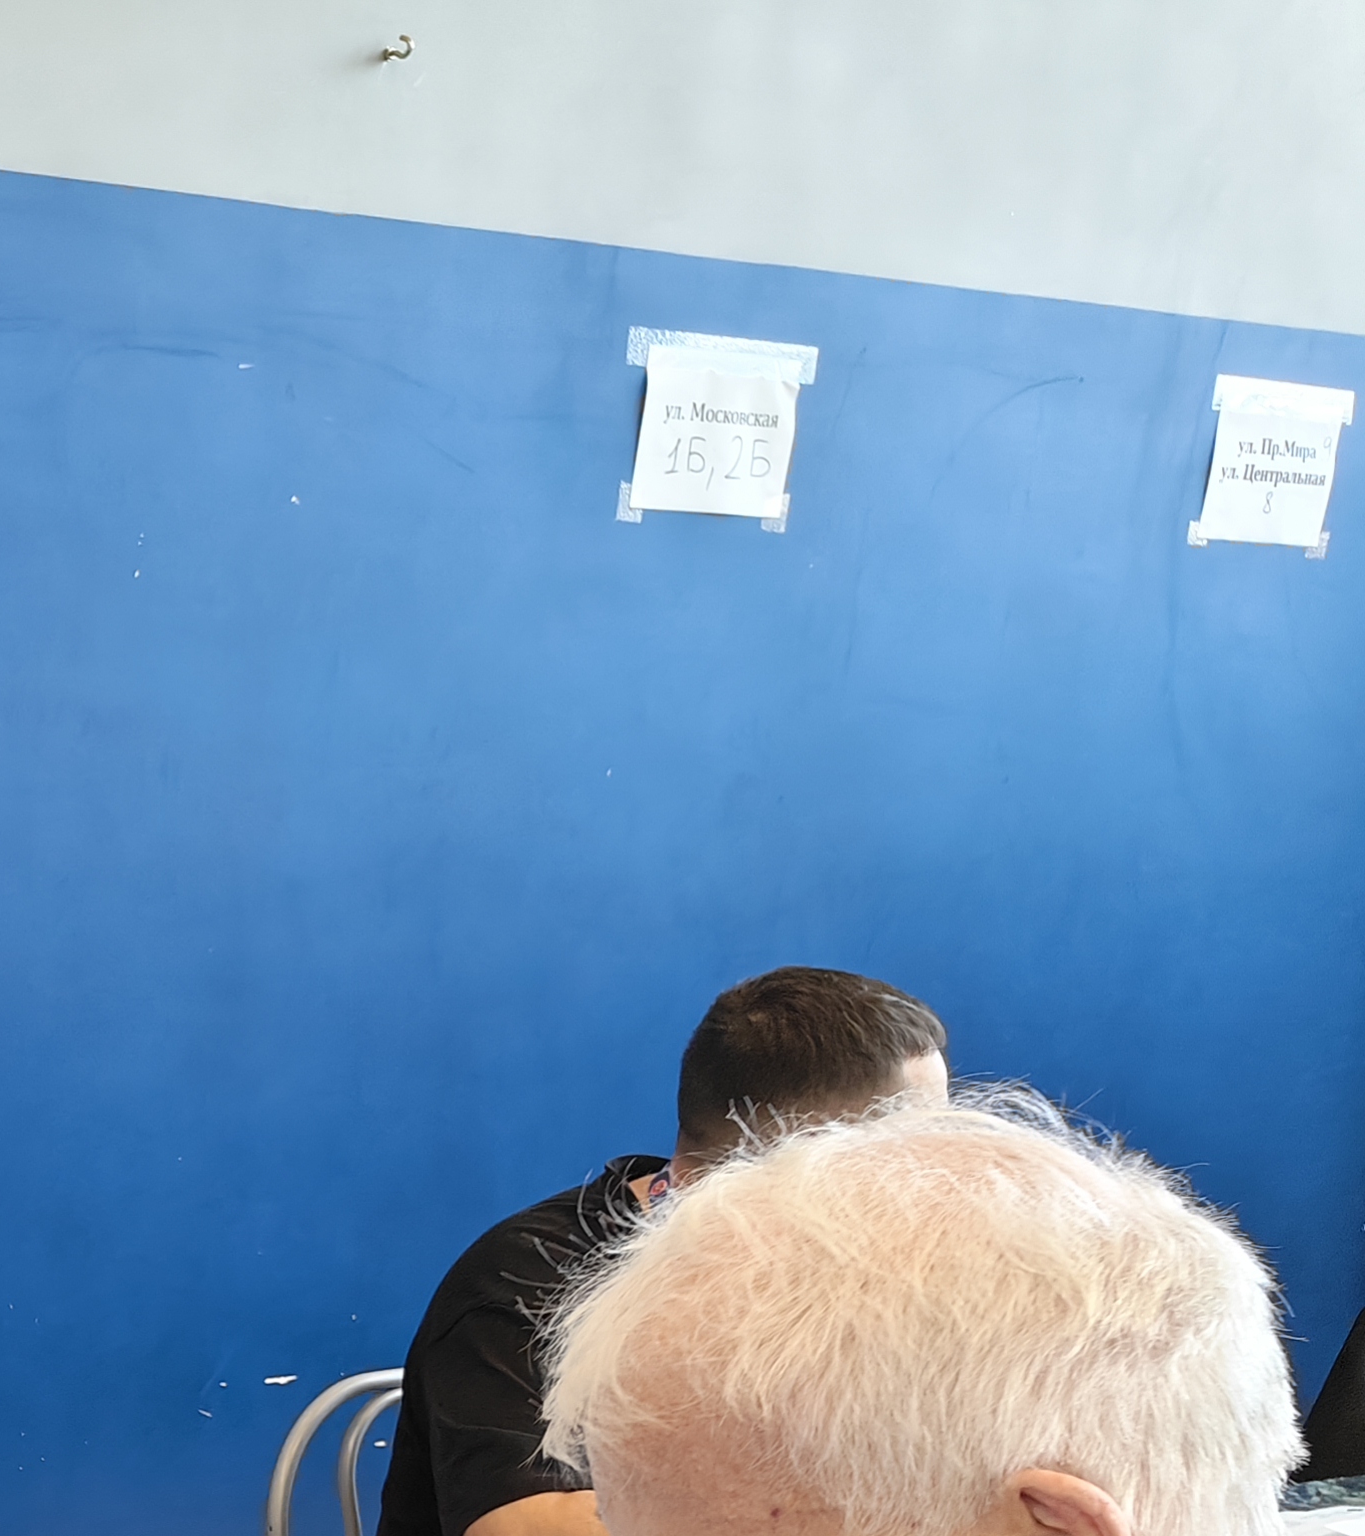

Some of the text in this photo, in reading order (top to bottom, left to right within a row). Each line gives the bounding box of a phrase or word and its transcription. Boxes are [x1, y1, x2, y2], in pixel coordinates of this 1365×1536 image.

[663, 402, 779, 429] ул. Московская
[1237, 440, 1257, 457] ул.
[1219, 464, 1326, 488] ул. Центральная
[1262, 491, 1274, 514] 8
